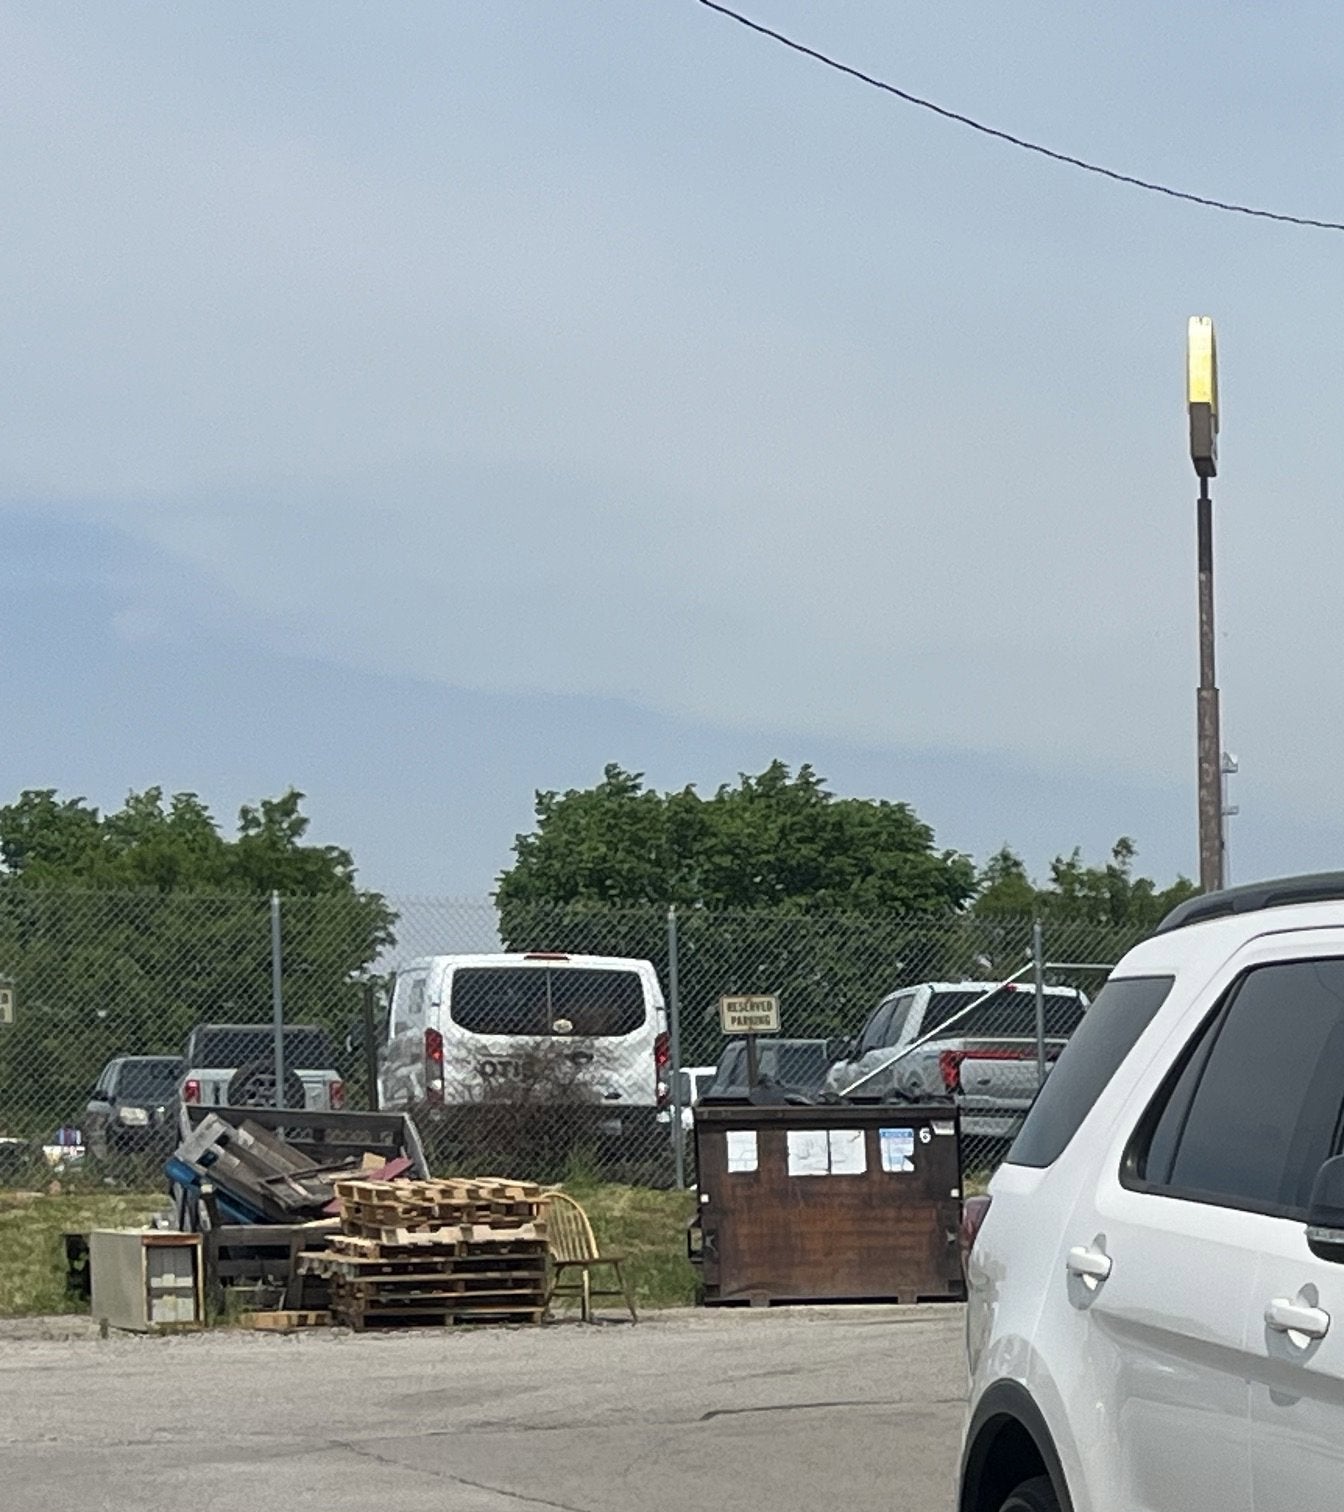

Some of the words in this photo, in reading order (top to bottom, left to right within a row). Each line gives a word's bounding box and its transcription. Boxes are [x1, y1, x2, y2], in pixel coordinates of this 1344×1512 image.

[727, 1000, 773, 1013] RESERVED
[731, 1015, 771, 1026] PARKING
[919, 1127, 932, 1144] 6
